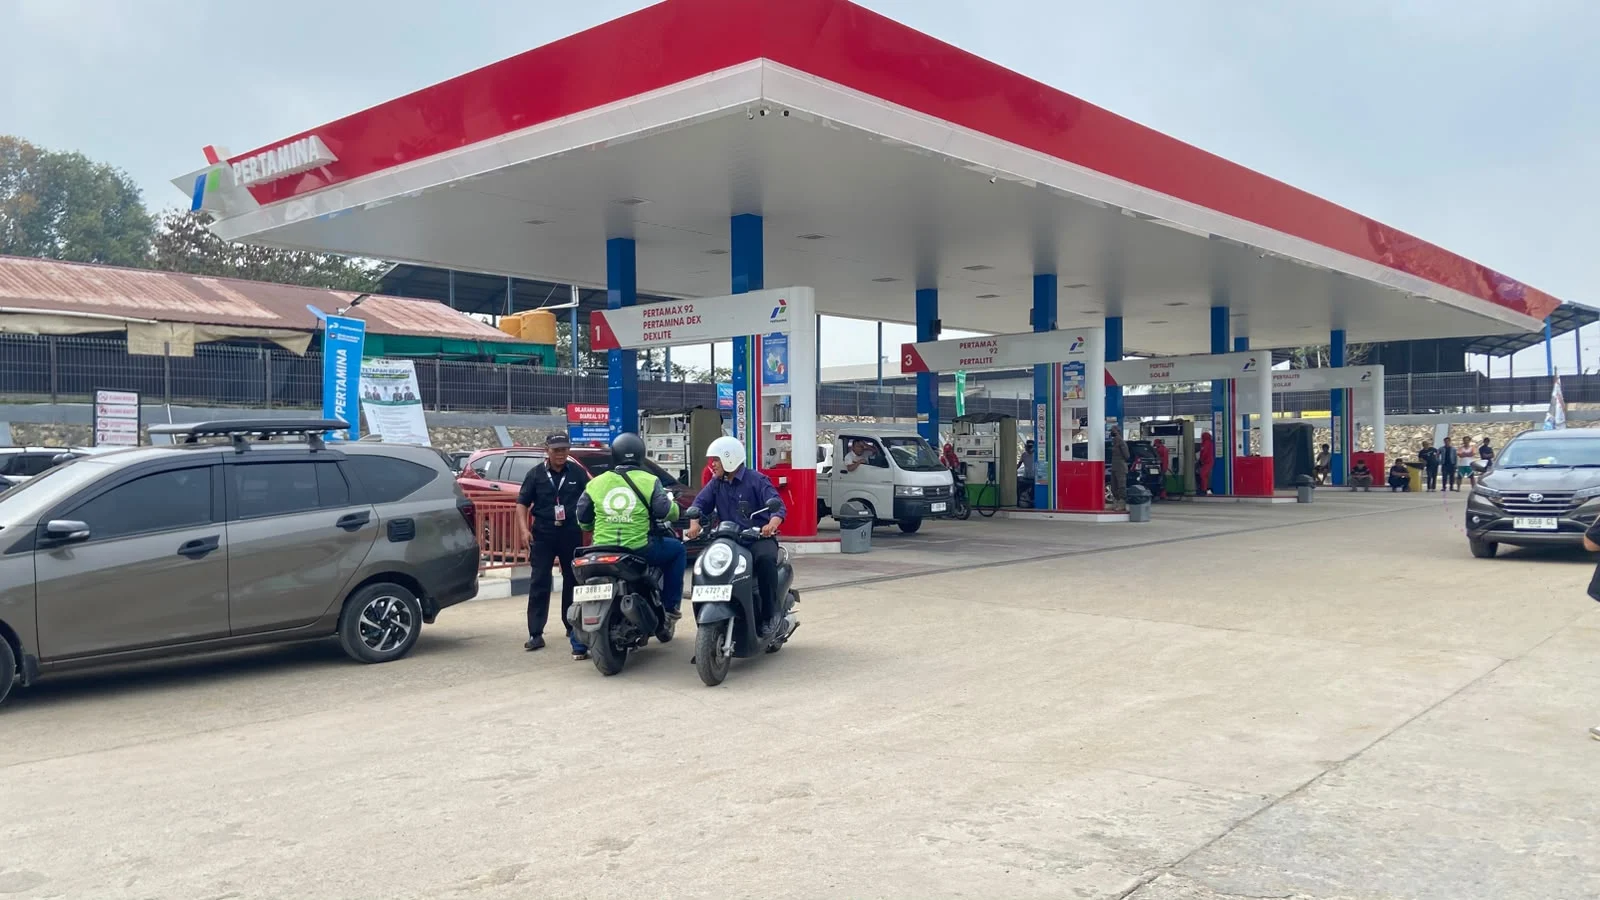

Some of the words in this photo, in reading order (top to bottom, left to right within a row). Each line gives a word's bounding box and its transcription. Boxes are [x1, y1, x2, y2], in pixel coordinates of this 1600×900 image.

[231, 134, 321, 187] PERTAMINA
[642, 305, 683, 318] PERTAMAX
[684, 304, 694, 313] 92
[642, 317, 685, 330] PERTAMINA
[686, 315, 702, 325] DEX
[595, 325, 601, 342] 1
[643, 330, 672, 341] DEXLITE
[959, 340, 998, 350] PERTAMAX
[905, 354, 913, 366] 3
[959, 357, 993, 366] PERTALITE
